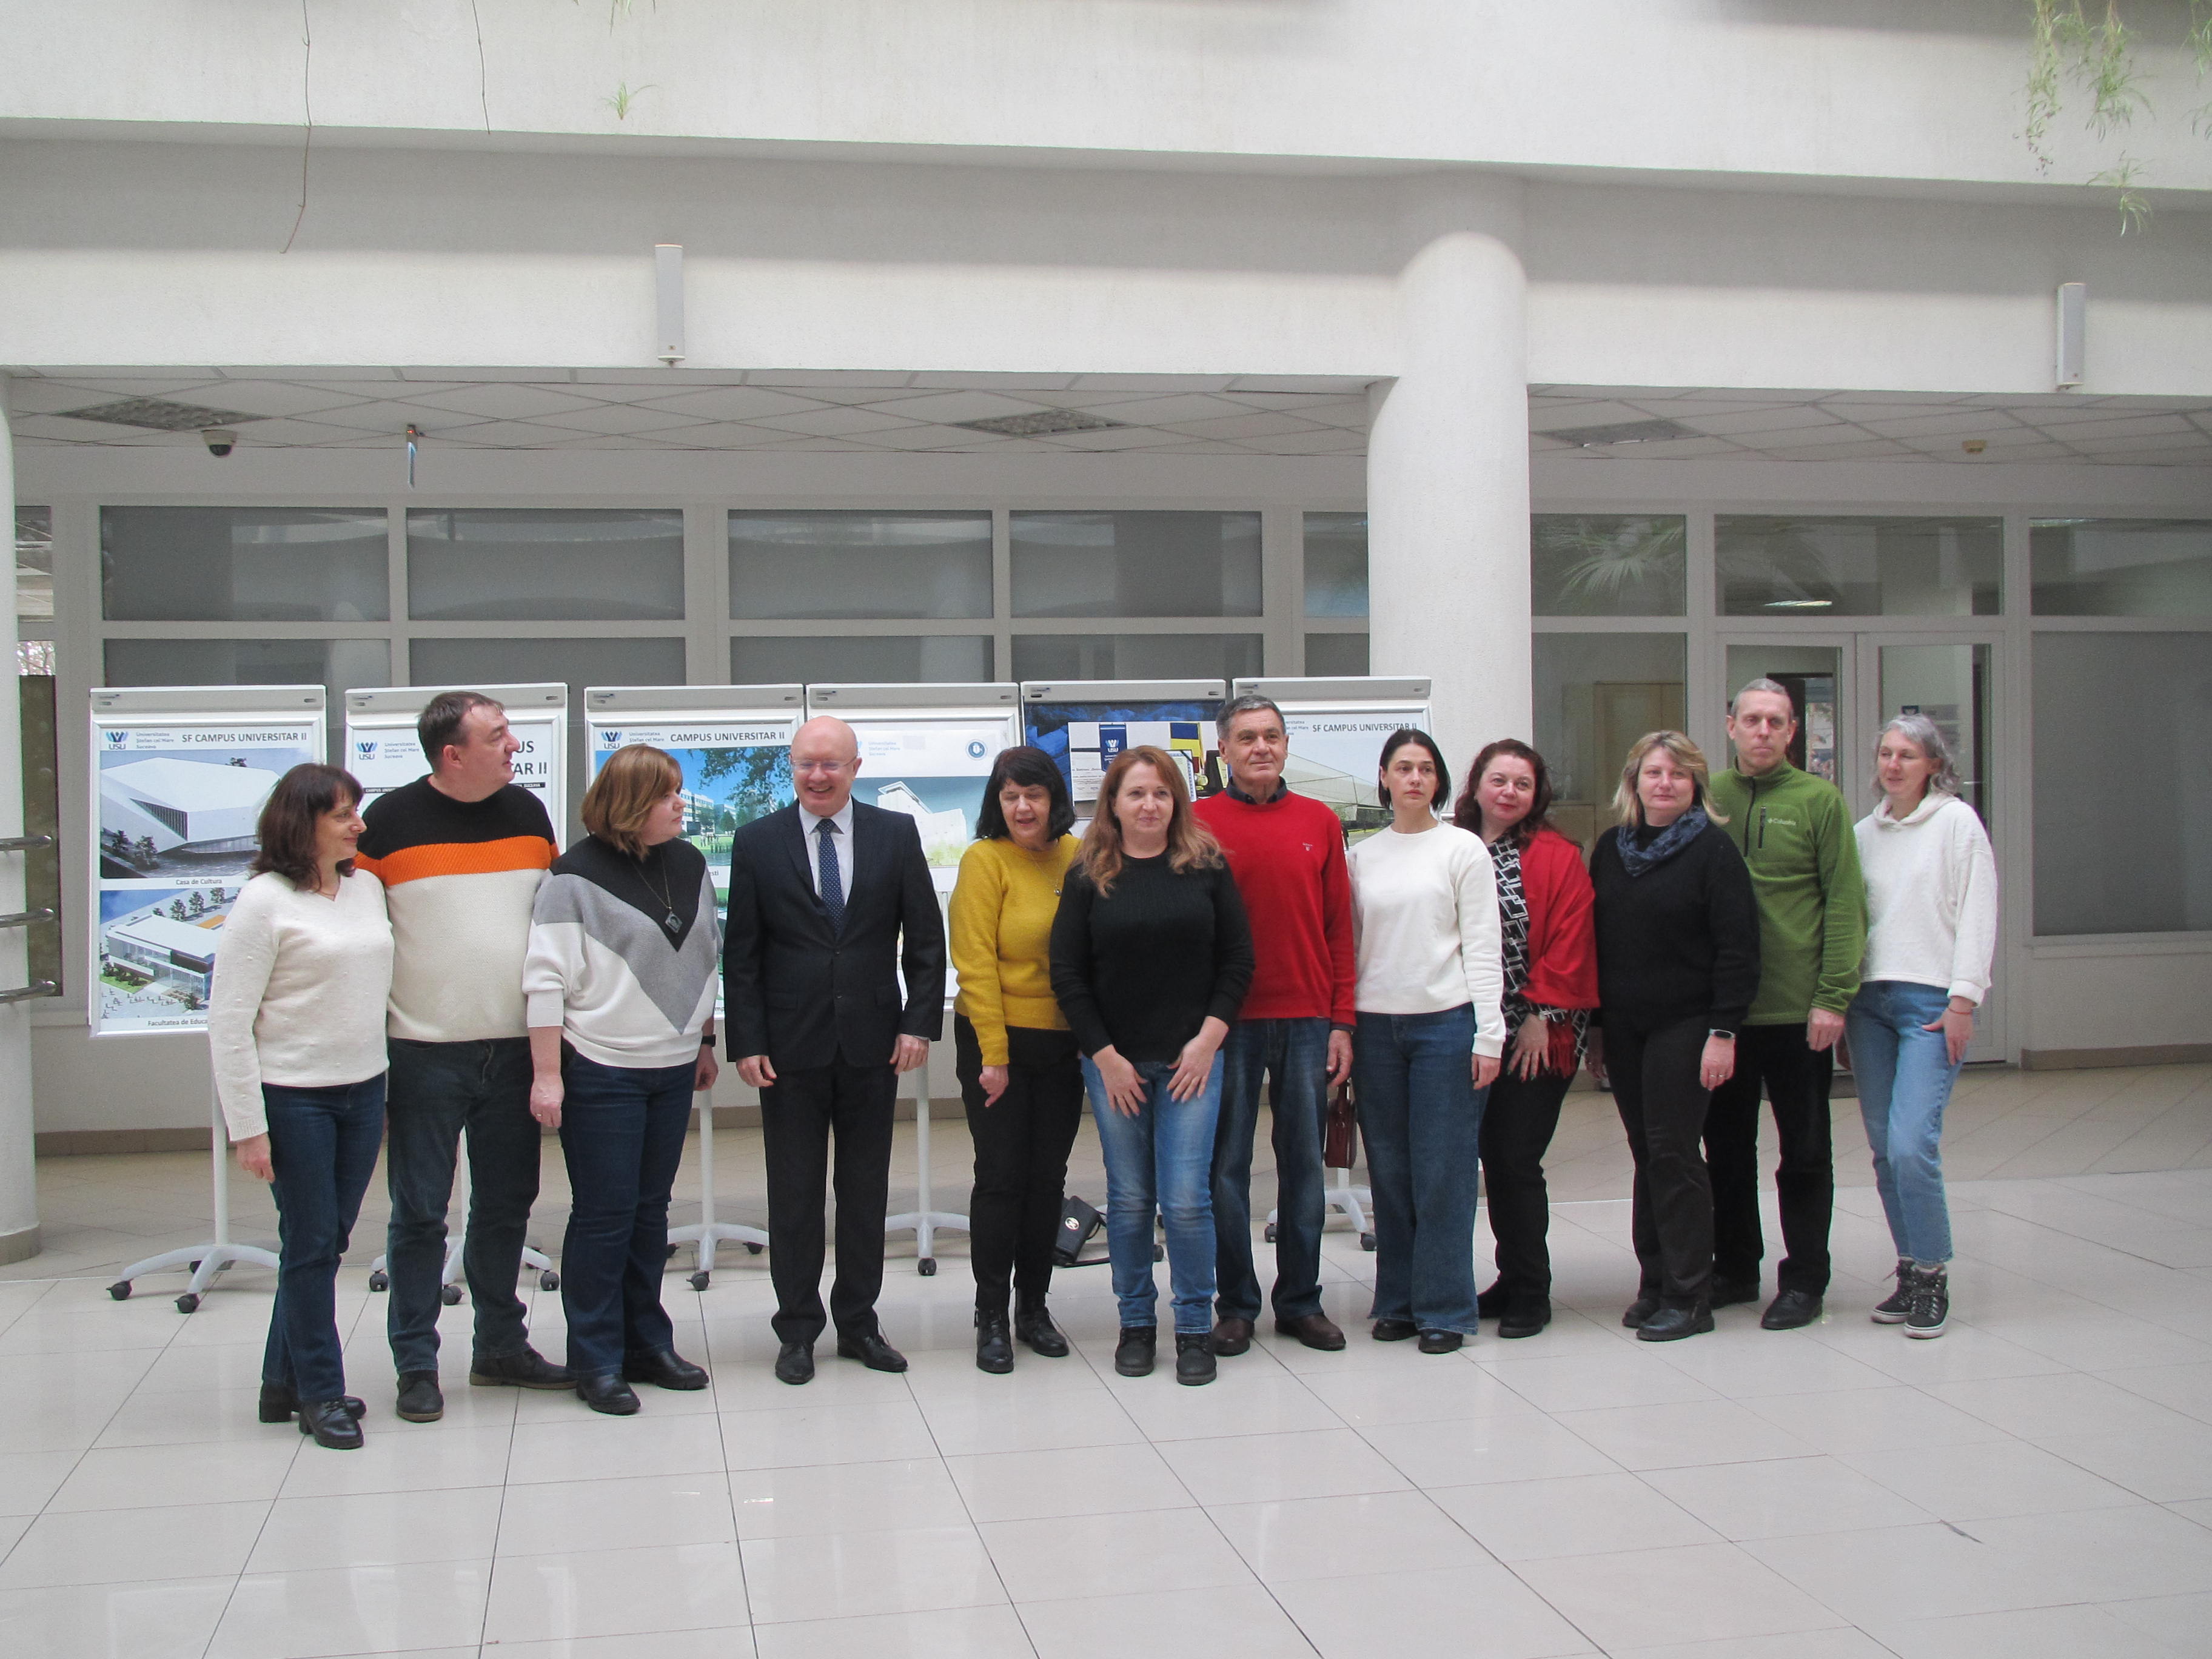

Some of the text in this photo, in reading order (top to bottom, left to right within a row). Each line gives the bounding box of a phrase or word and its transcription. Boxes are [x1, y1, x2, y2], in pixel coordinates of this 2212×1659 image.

[182, 732, 307, 743] SF CAMPUS UNIVERSITAR II
[670, 733, 712, 742] CAMPUS
[714, 732, 777, 741] UNIVERSITAR
[538, 762, 547, 774] II
